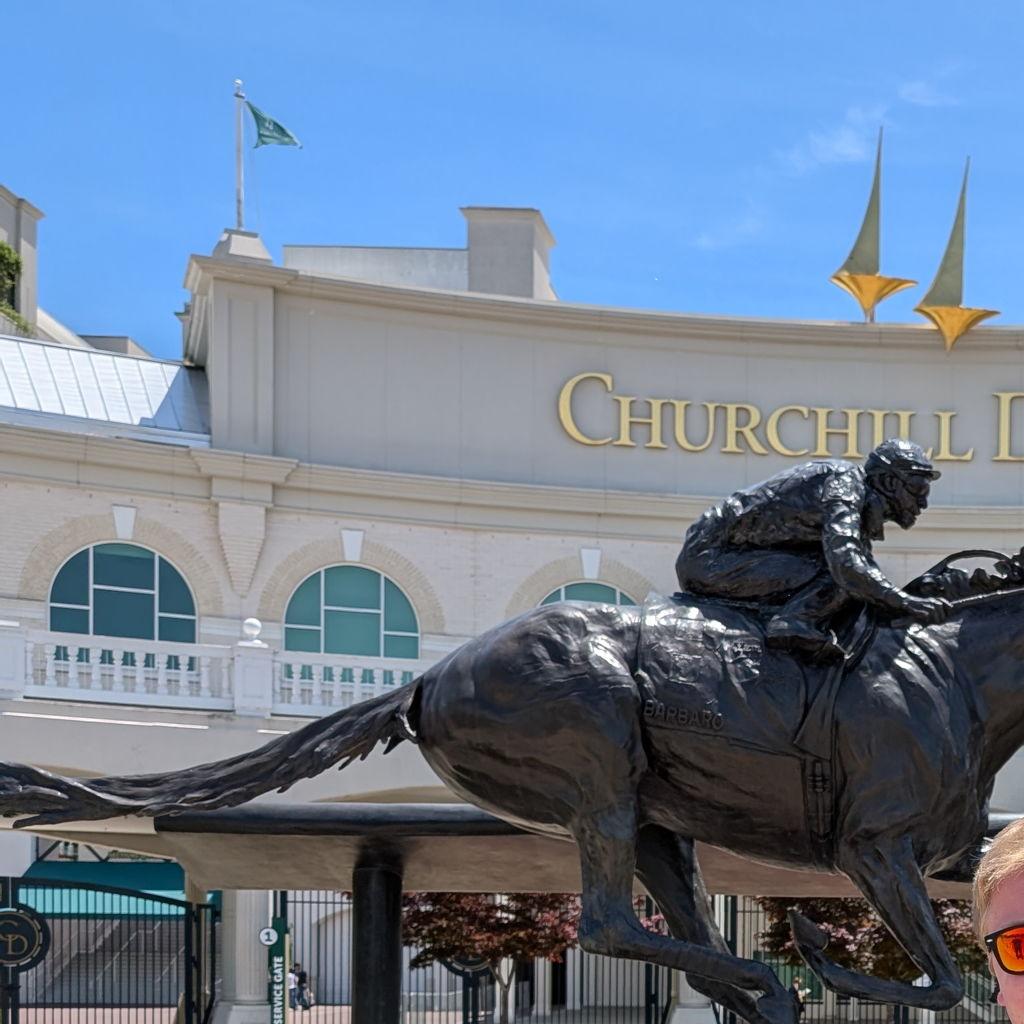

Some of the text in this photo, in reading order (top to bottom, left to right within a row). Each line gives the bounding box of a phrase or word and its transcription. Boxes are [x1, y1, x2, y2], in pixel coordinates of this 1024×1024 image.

[643, 699, 724, 730] BARBARO
[264, 931, 273, 942] 1
[273, 955, 284, 983] GATE
